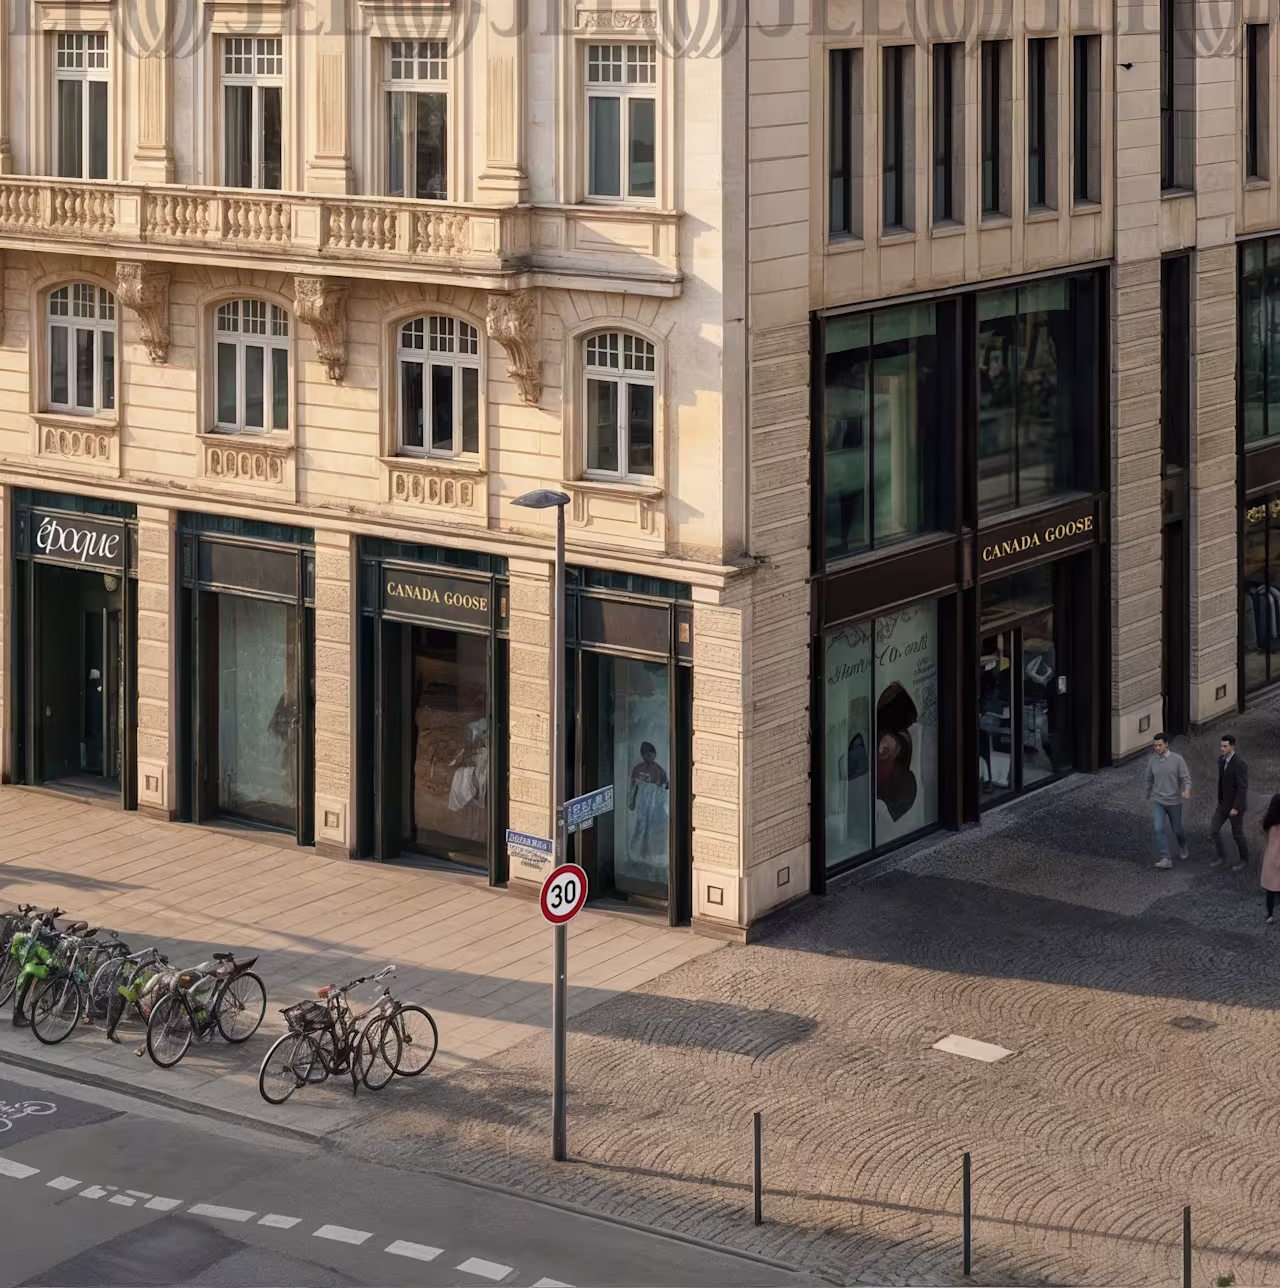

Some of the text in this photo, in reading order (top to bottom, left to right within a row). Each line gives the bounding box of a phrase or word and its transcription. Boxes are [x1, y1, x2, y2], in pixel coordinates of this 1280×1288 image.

[36, 516, 120, 562] époque
[982, 515, 1093, 562] CANADA GOOSE
[387, 581, 488, 612] CANADA GOOSE
[550, 879, 576, 909] 30
